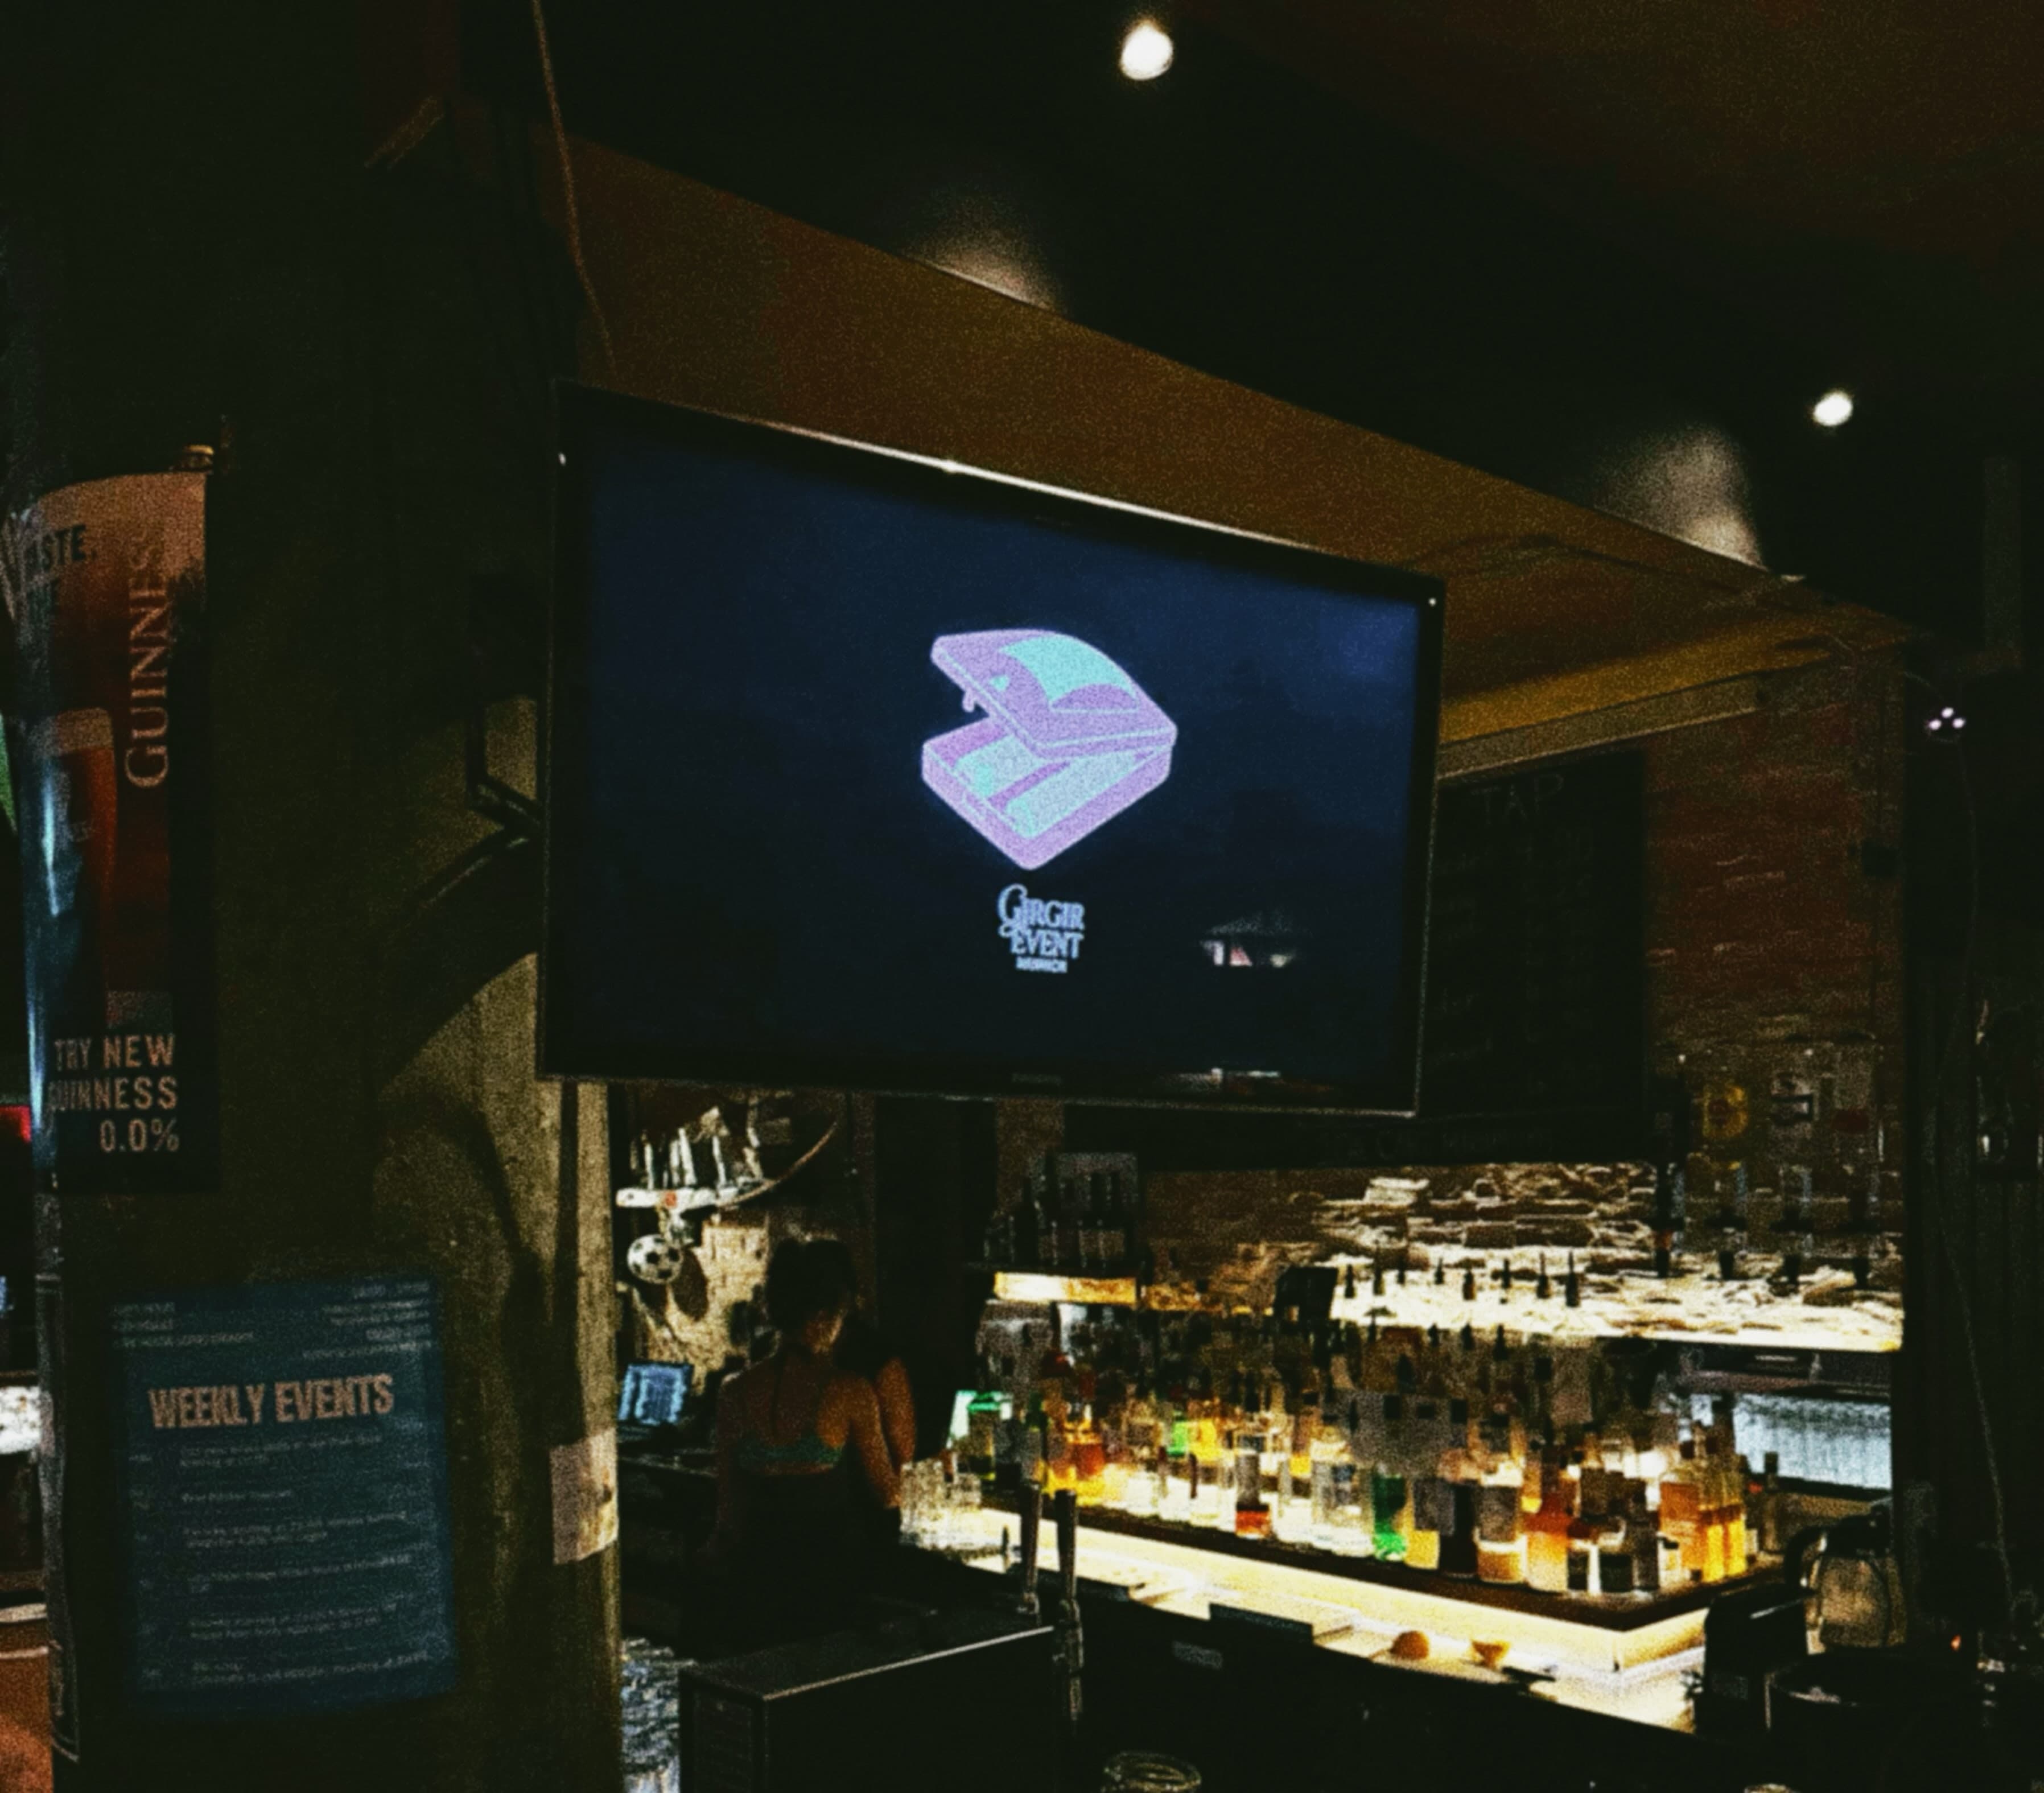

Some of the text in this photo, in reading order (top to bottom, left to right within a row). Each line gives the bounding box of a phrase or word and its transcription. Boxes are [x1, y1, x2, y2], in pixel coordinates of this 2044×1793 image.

[1011, 928, 1085, 959] EVENT
[54, 1032, 175, 1071] TRY NEW
[99, 1116, 180, 1153] 0.0%
[148, 1372, 395, 1429] WEEKLY EVENTS
